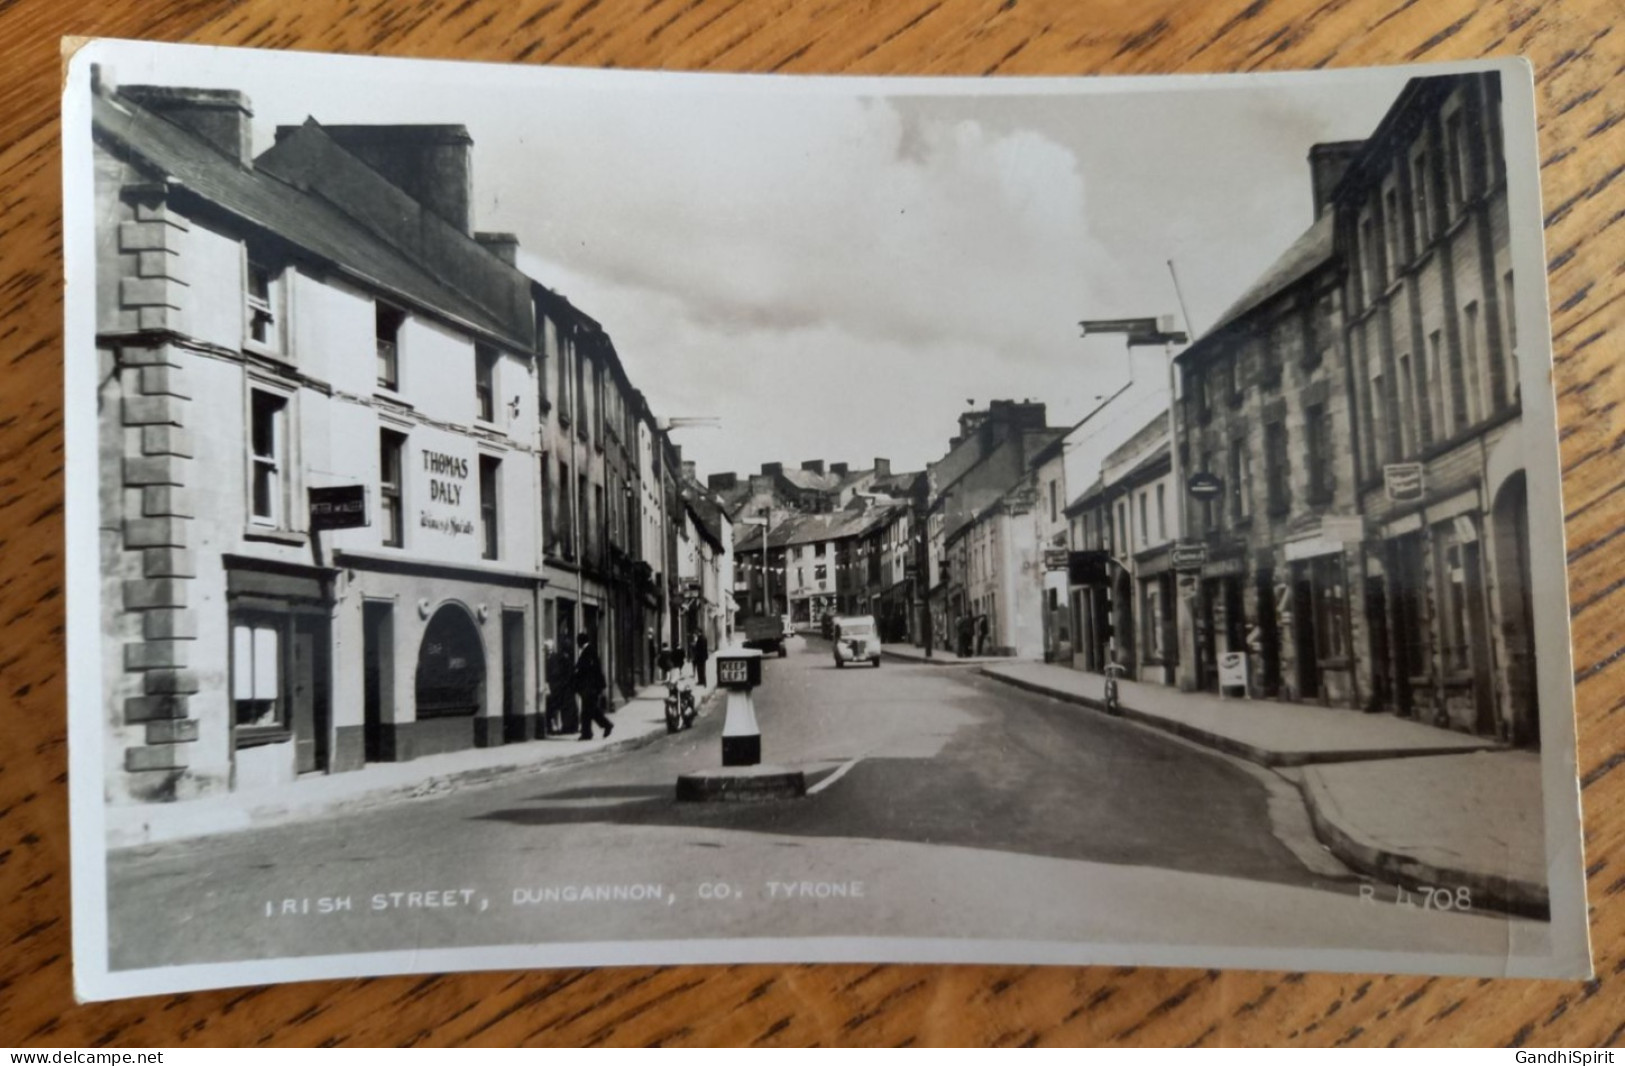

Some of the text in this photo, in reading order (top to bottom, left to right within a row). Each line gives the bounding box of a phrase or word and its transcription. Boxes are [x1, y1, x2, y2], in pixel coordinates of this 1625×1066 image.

[421, 449, 468, 479] THOMAS
[431, 479, 462, 506] DALY
[721, 661, 747, 671] KEEP
[721, 671, 747, 682] LEFT
